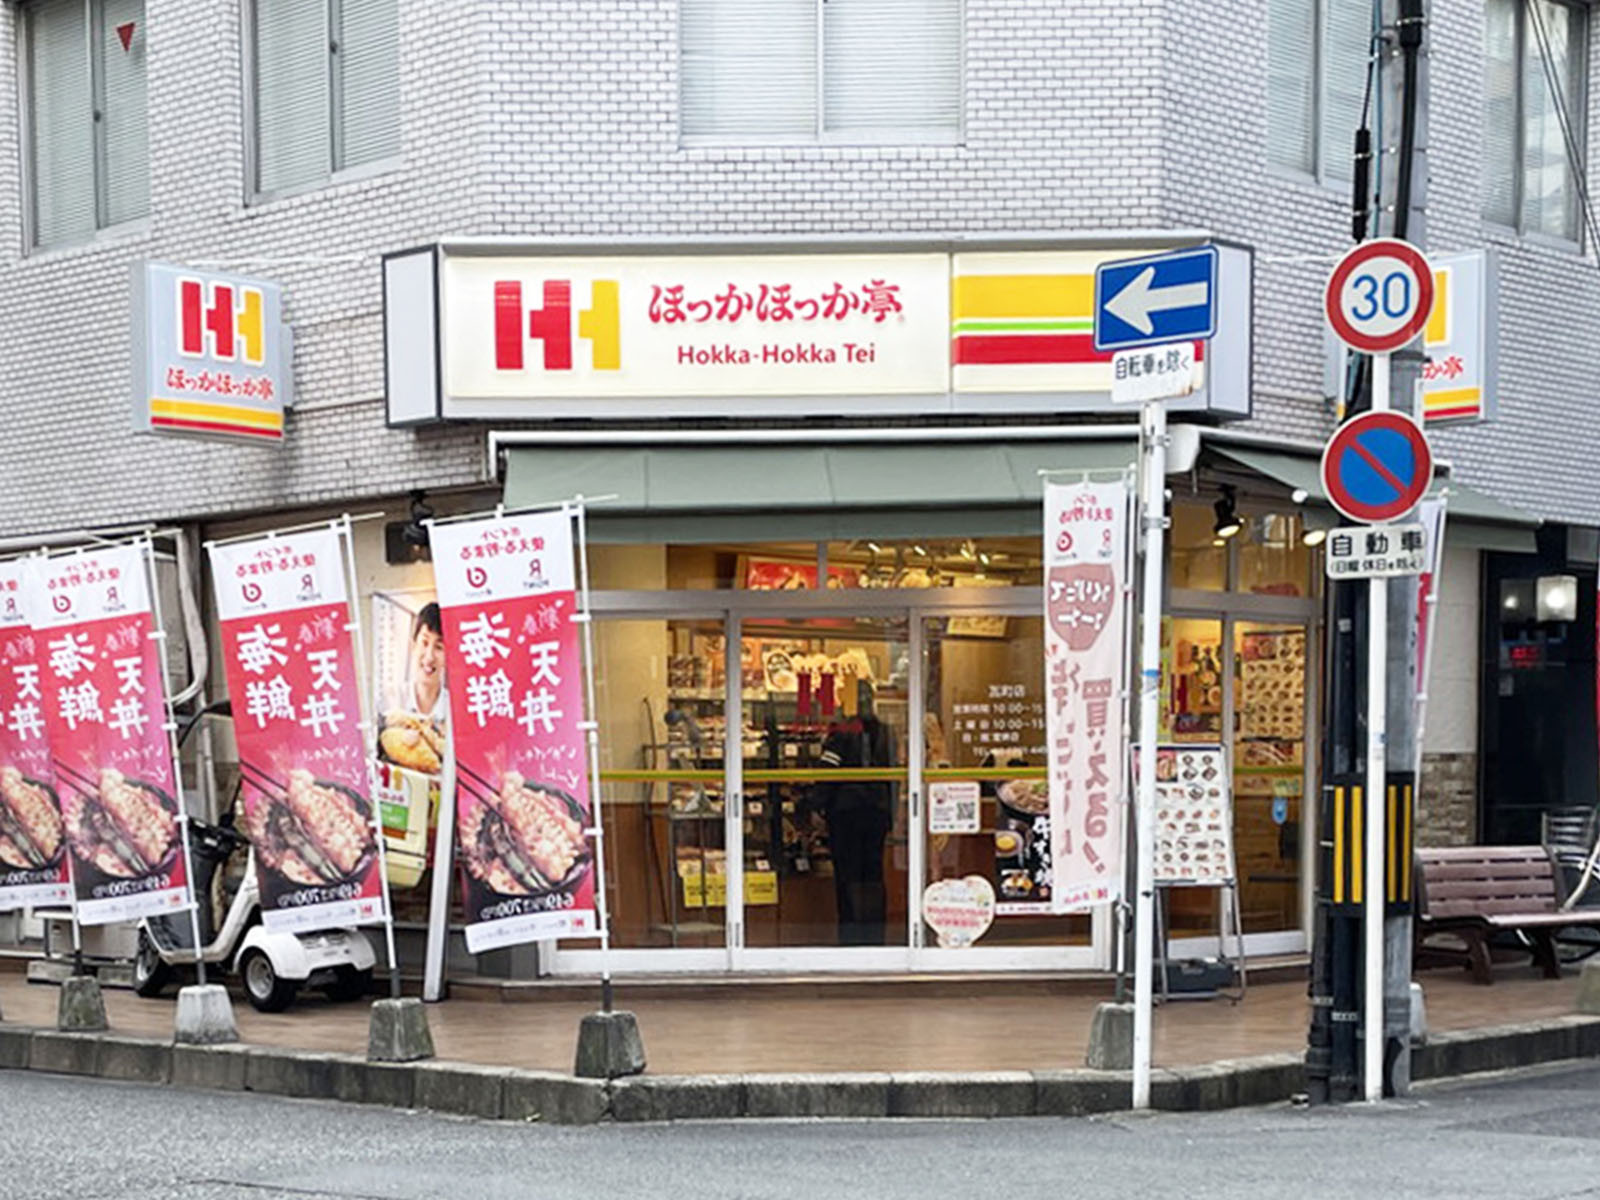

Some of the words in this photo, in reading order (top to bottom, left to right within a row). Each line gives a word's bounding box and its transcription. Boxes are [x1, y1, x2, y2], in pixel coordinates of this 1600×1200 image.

[648, 279, 902, 324] ほっかほっか亭
[1352, 271, 1410, 322] 30
[677, 344, 836, 365] Hokka-Hokka
[844, 342, 875, 364] Tei
[1115, 350, 1190, 380] 自転車を除く
[166, 367, 275, 400] ほっかほっか亭
[1332, 530, 1423, 557] 自動車
